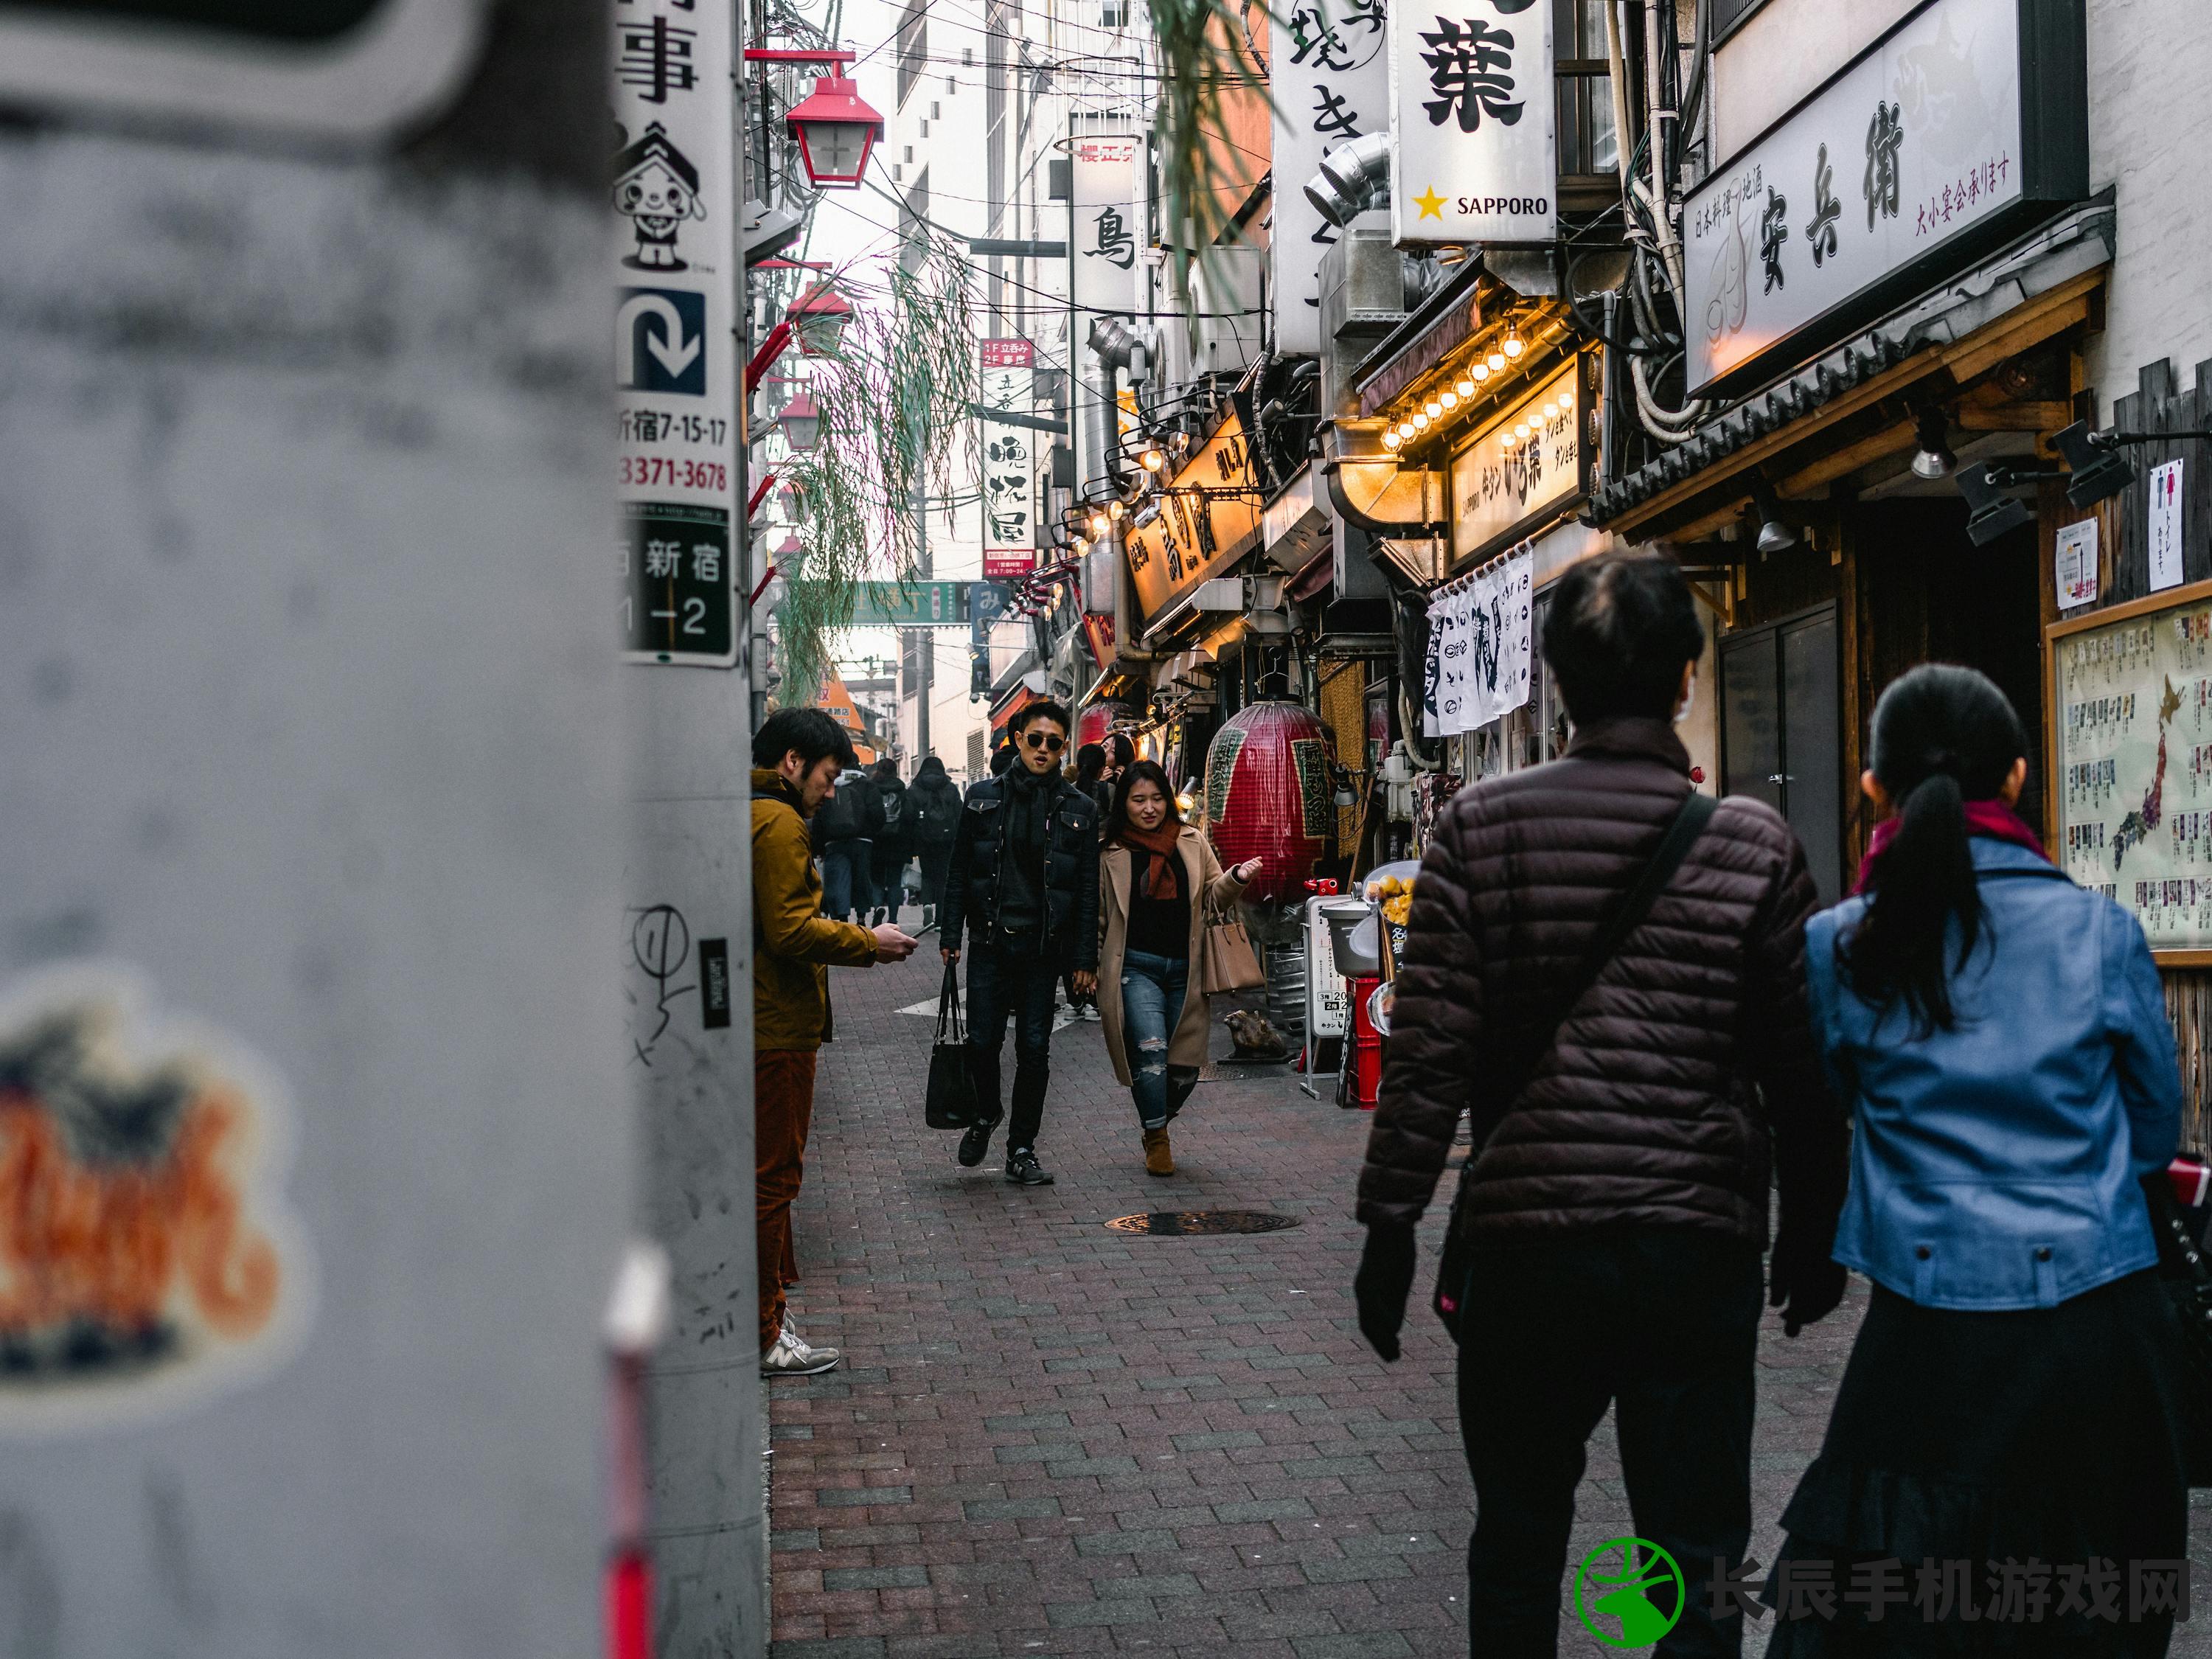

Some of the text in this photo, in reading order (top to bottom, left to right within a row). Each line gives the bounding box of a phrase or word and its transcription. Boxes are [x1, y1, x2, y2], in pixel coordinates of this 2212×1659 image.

[1417, 0, 1539, 133] 葉
[1458, 197, 1548, 215] SAPPORO
[1760, 100, 1904, 296] 安兵衛
[1916, 149, 2009, 237] 大小宴会承ります
[1000, 343, 1029, 353] 立呑み
[1004, 355, 1026, 365] 座席
[990, 436, 1027, 542] 晩杯屋
[1462, 490, 1480, 518] SAPPORO
[1482, 465, 1501, 504] 牛タン
